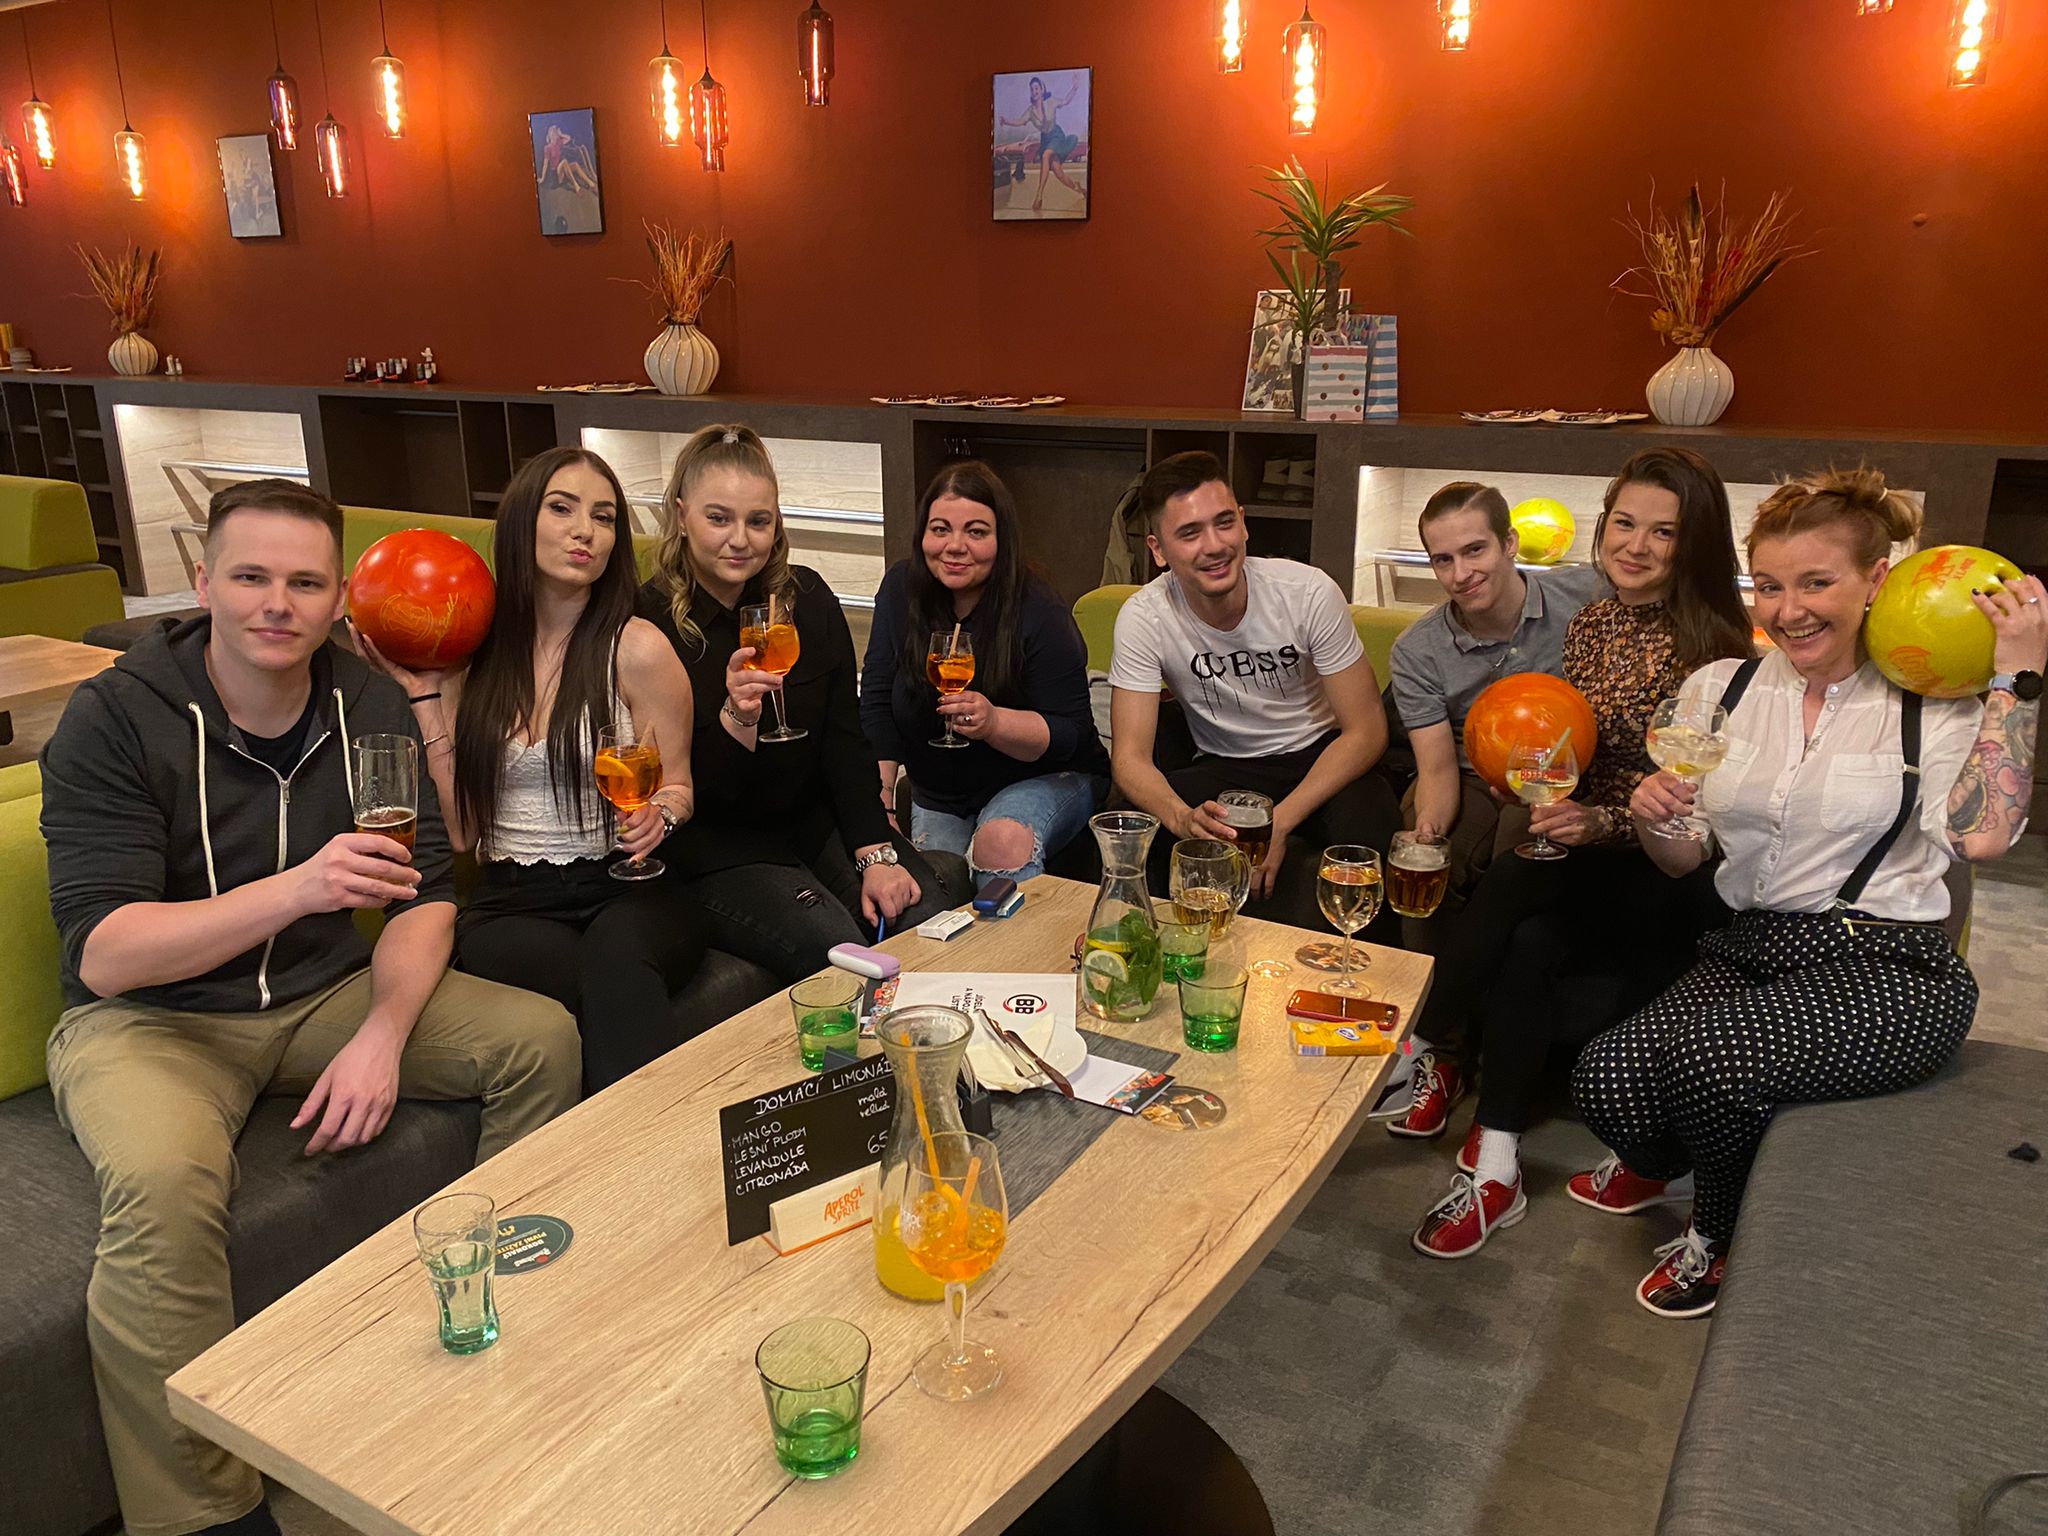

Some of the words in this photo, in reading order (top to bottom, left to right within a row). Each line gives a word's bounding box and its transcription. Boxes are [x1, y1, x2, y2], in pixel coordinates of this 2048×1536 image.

[973, 993, 986, 1013] JÍDELN
[1015, 999, 1035, 1014] BB
[753, 1076, 824, 1115] DOMÁCÍ
[832, 1057, 893, 1090] LIMONÁD
[731, 1121, 782, 1149] MANGO
[734, 1138, 770, 1165] LESNÍ
[772, 1126, 807, 1148] PLODY
[867, 1129, 888, 1154] 65
[734, 1144, 806, 1180] LEVANDULE
[735, 1161, 810, 1196] CITRONÁDA
[824, 1185, 865, 1222] APEROL
[833, 1200, 860, 1225] SPRITZ
